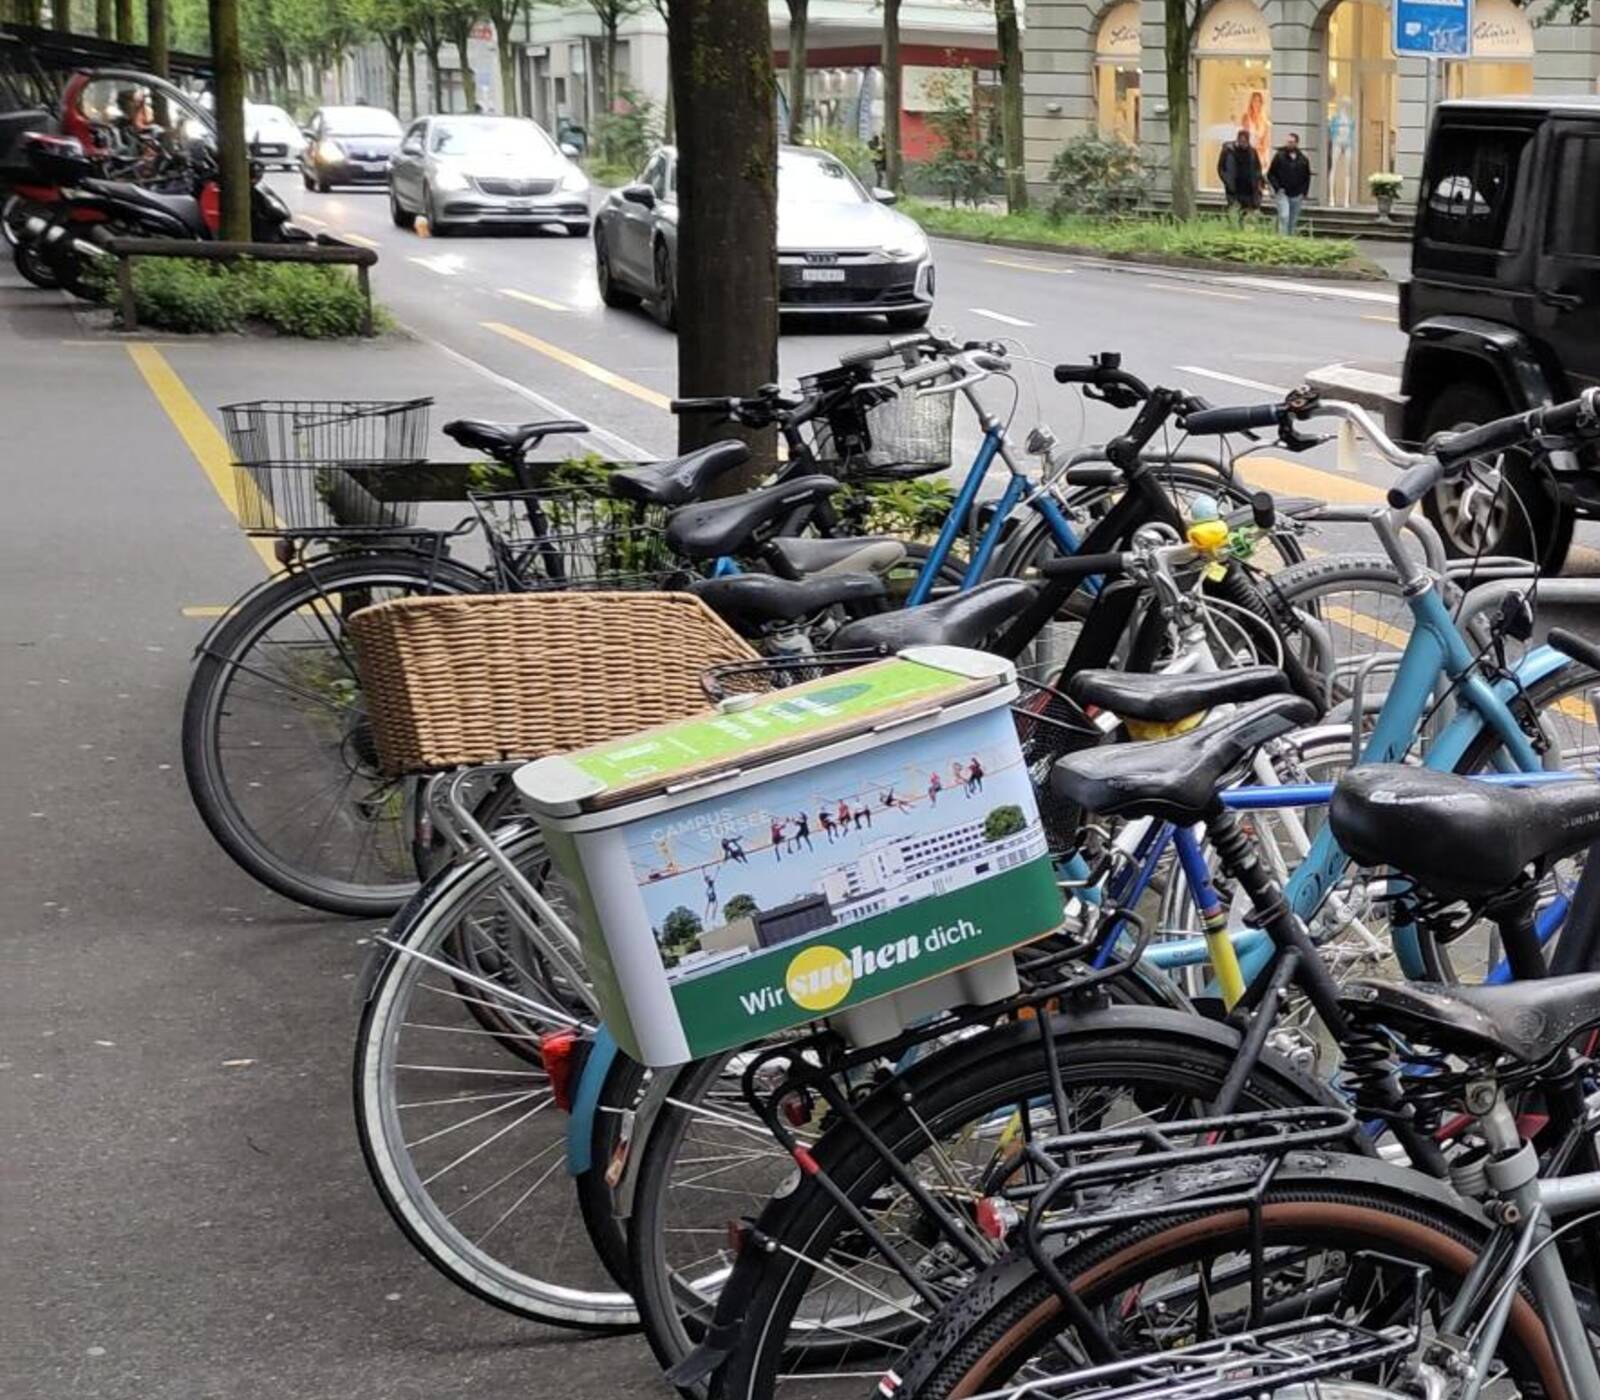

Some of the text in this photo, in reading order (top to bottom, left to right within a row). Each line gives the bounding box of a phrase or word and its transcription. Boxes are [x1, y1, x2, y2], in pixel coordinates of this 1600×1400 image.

[651, 807, 734, 842] CAMPUS
[739, 918, 983, 1016] Wir suchen dich.
